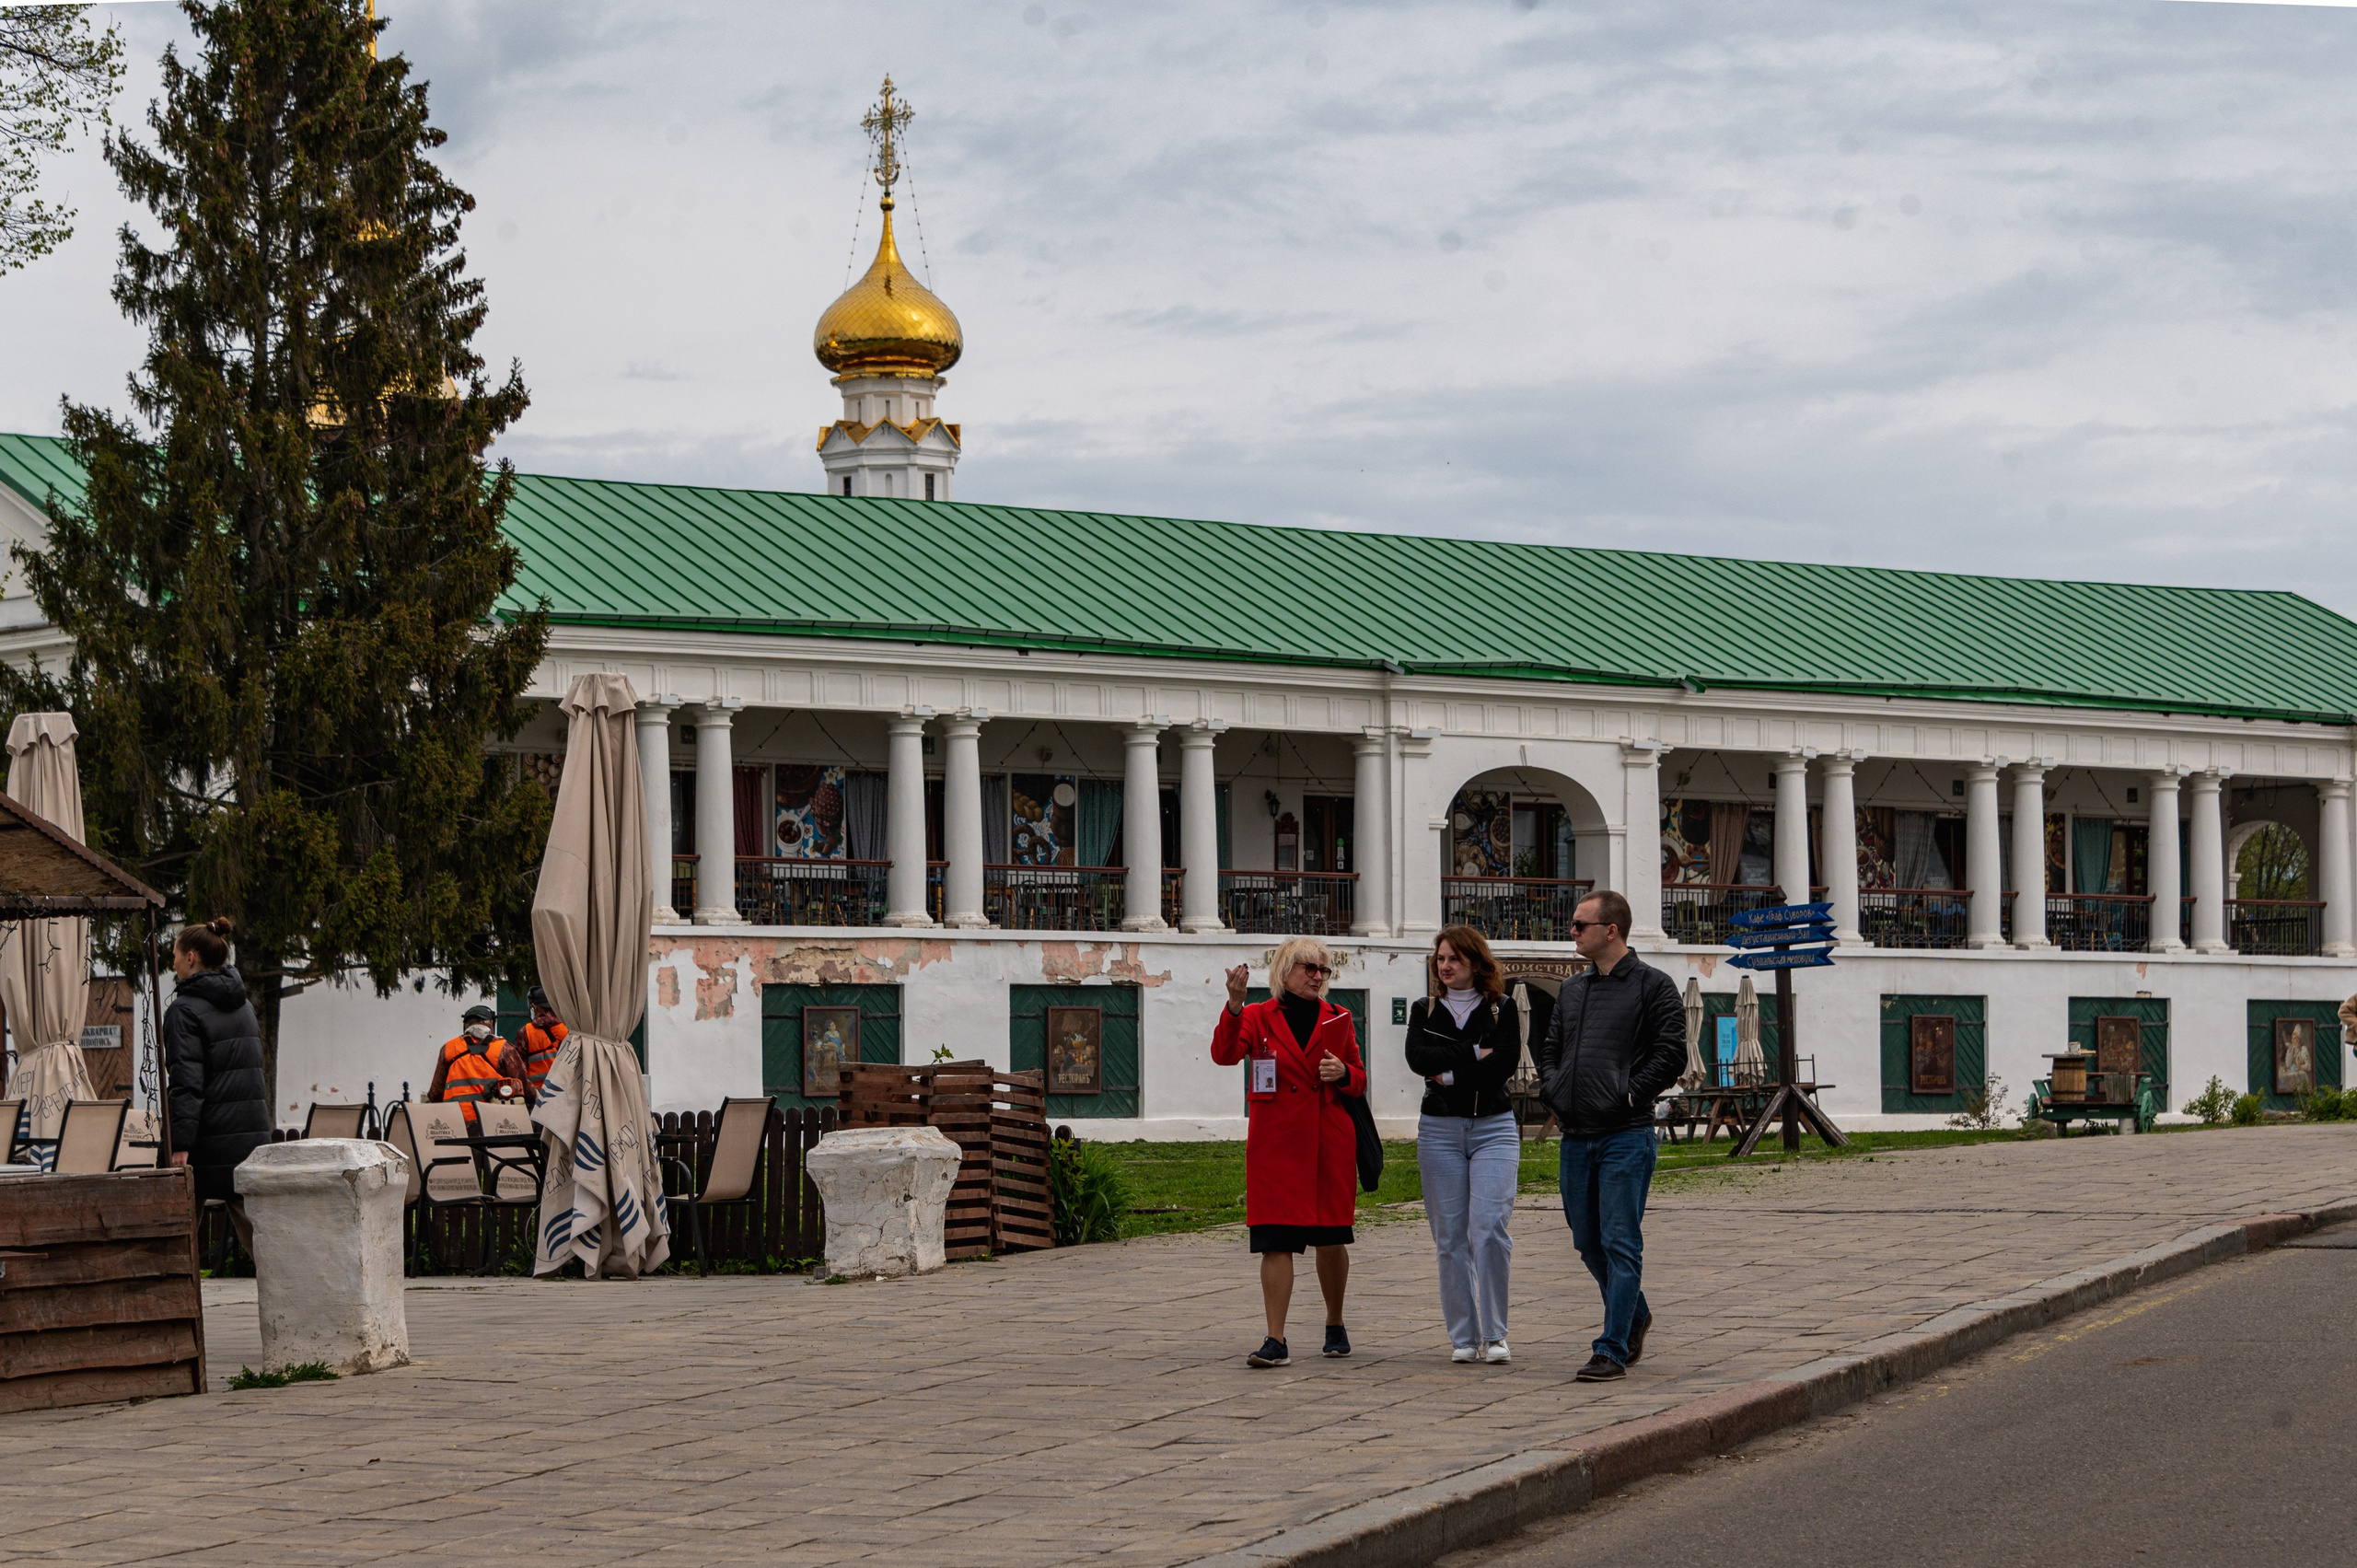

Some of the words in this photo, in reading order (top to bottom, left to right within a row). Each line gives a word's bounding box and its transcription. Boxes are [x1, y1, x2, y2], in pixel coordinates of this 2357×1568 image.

[1748, 913, 1765, 924] Кафе
[1784, 909, 1815, 922] Суворов»
[1504, 963, 1573, 977] КОМСТВА
[80, 1038, 112, 1048] ИВОПИСЬ
[1058, 1074, 1090, 1084] РЕСТОРАНЪ
